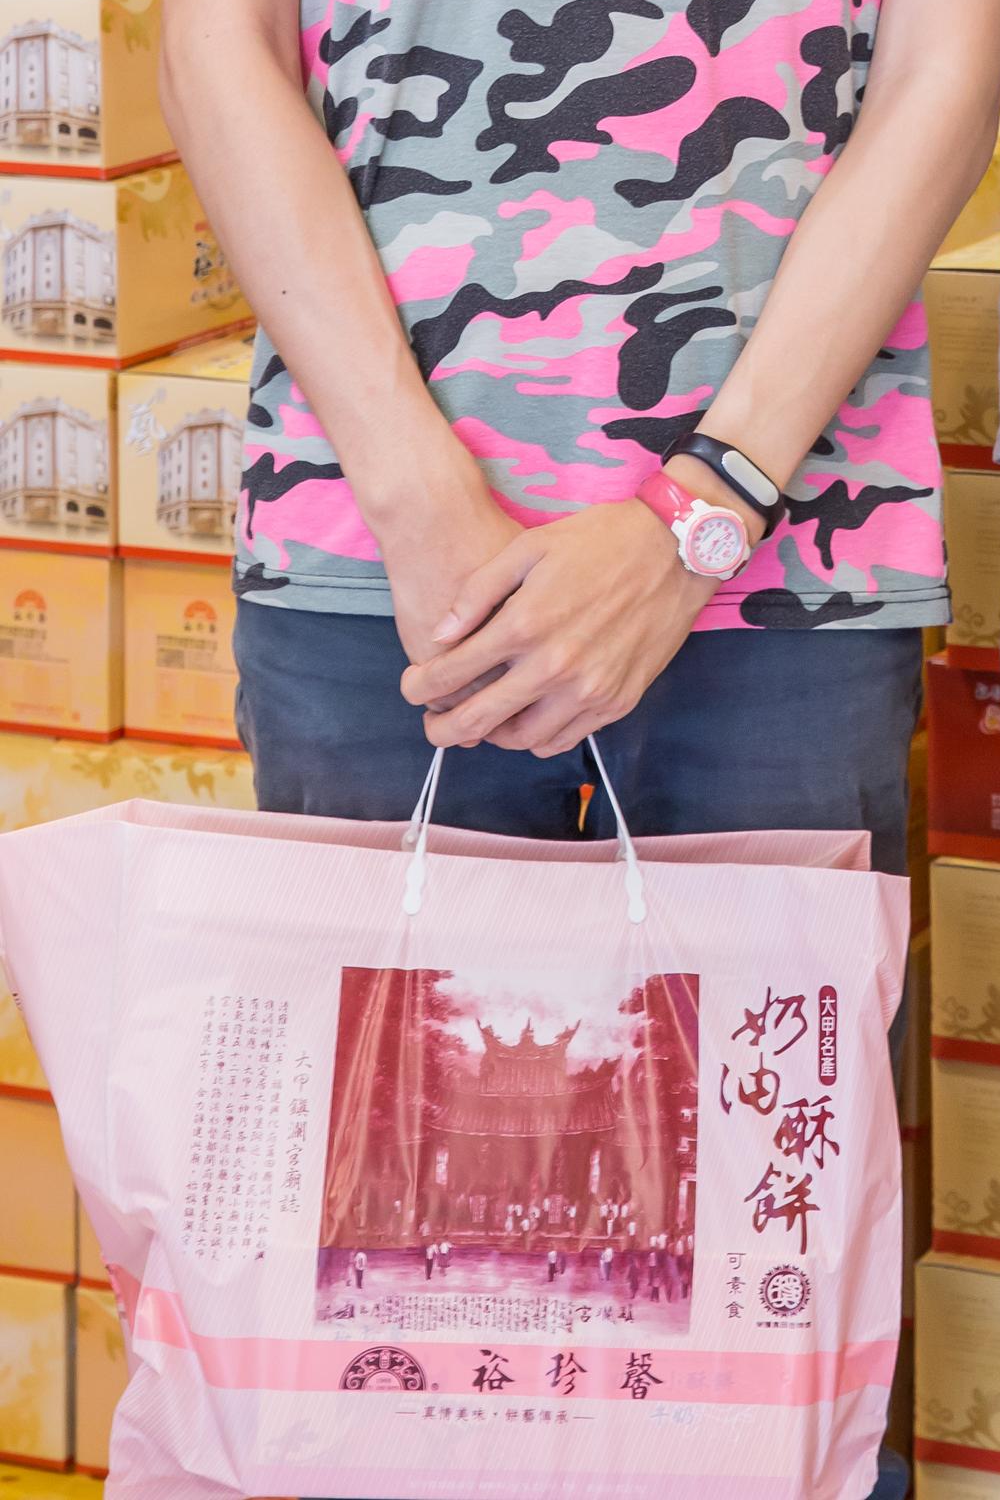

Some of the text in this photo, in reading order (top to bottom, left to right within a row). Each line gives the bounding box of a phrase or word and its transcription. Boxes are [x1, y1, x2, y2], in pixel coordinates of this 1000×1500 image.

[820, 994, 837, 1078] 大甲名產
[720, 985, 840, 1256] 奶油酥餅
[725, 1251, 747, 1319] 可素食
[471, 1348, 664, 1400] 裕珍馨
